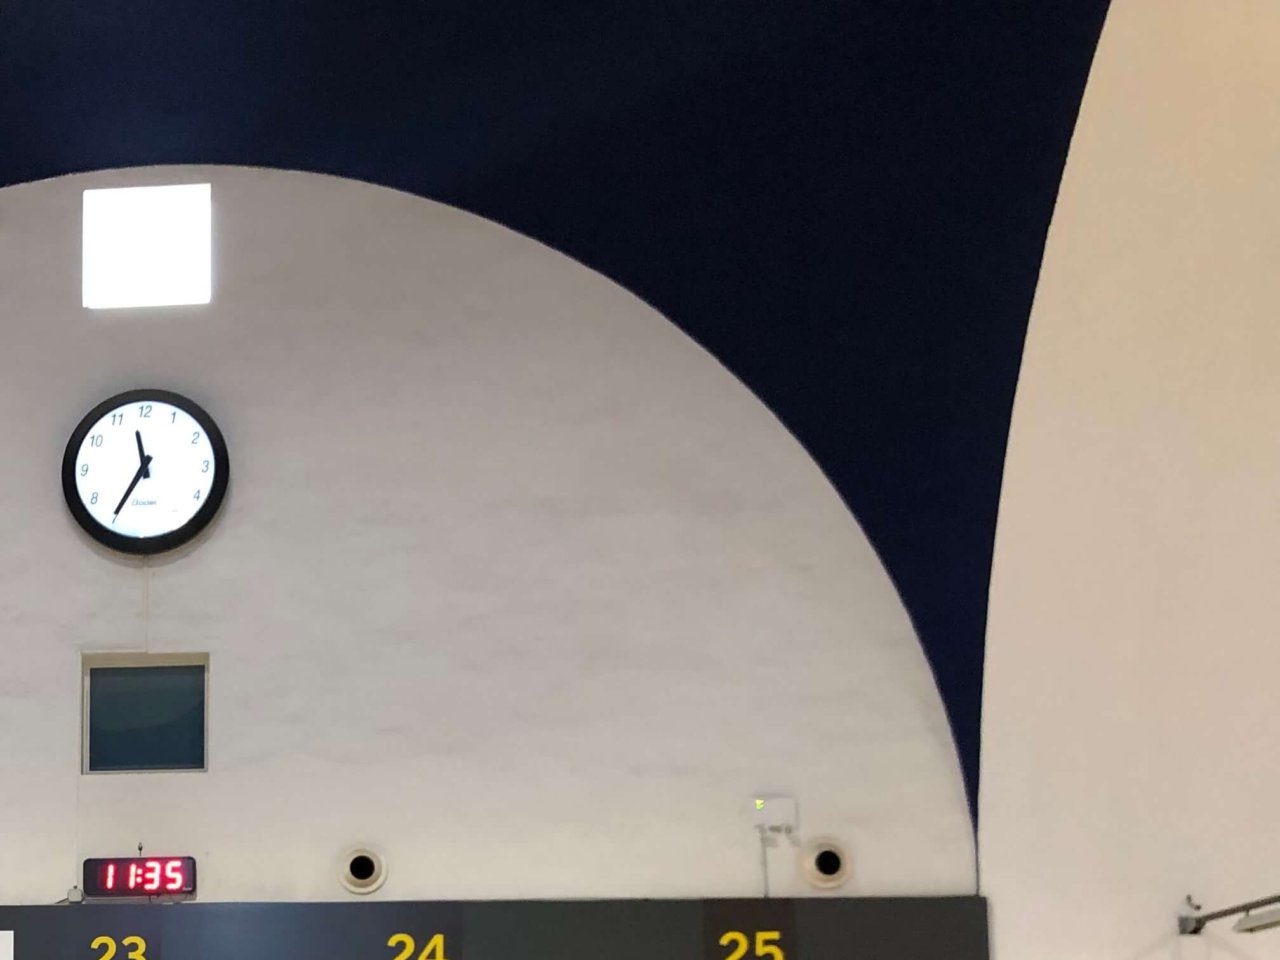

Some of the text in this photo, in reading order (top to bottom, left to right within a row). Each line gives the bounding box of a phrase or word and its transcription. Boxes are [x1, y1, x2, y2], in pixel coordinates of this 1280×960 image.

[138, 405, 153, 418] 12
[170, 411, 177, 424] 1
[111, 413, 124, 426] 11
[89, 434, 104, 448] 10
[191, 431, 200, 445] 2
[80, 463, 89, 477] 9
[201, 460, 210, 473] 3
[90, 491, 99, 505] 8
[192, 489, 201, 501] 4
[106, 860, 183, 890] 11:35
